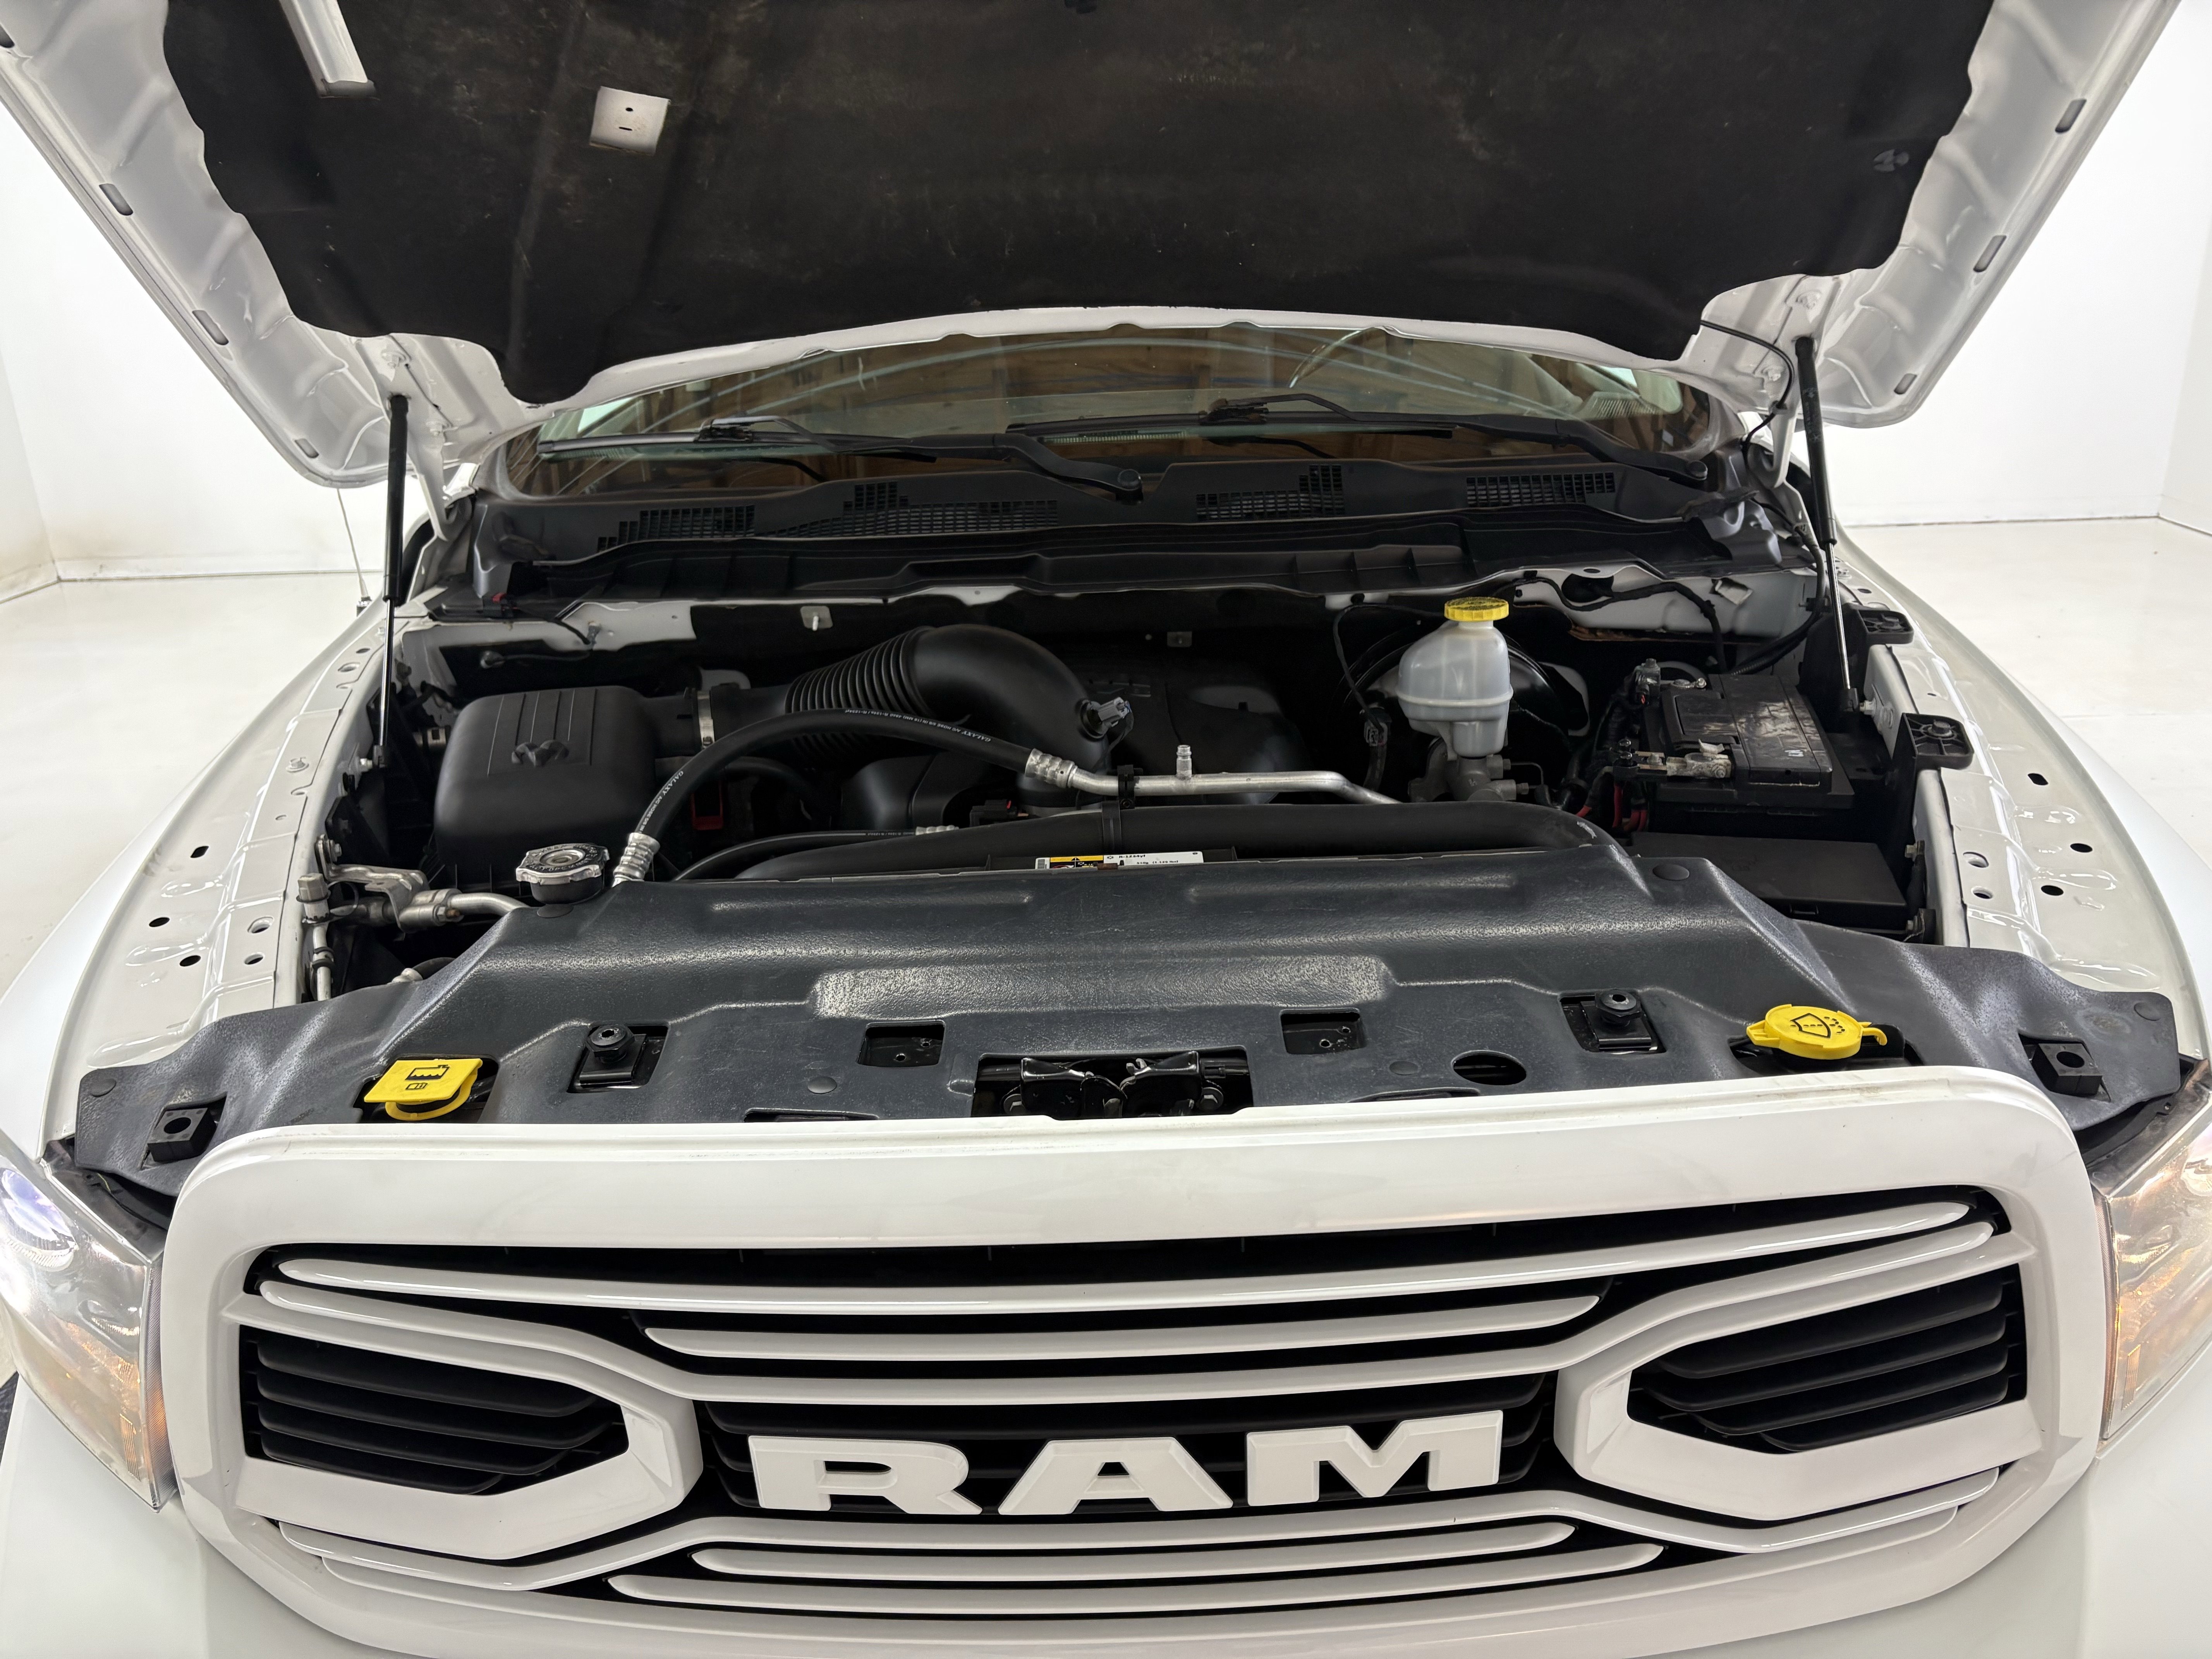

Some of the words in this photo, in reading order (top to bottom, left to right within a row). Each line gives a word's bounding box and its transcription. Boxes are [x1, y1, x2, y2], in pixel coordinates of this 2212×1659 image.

[962, 730, 991, 742] GALAXY
[662, 771, 684, 796] GALAXY
[647, 804, 657, 818] HOSE
[748, 1410, 1503, 1516] RAM
